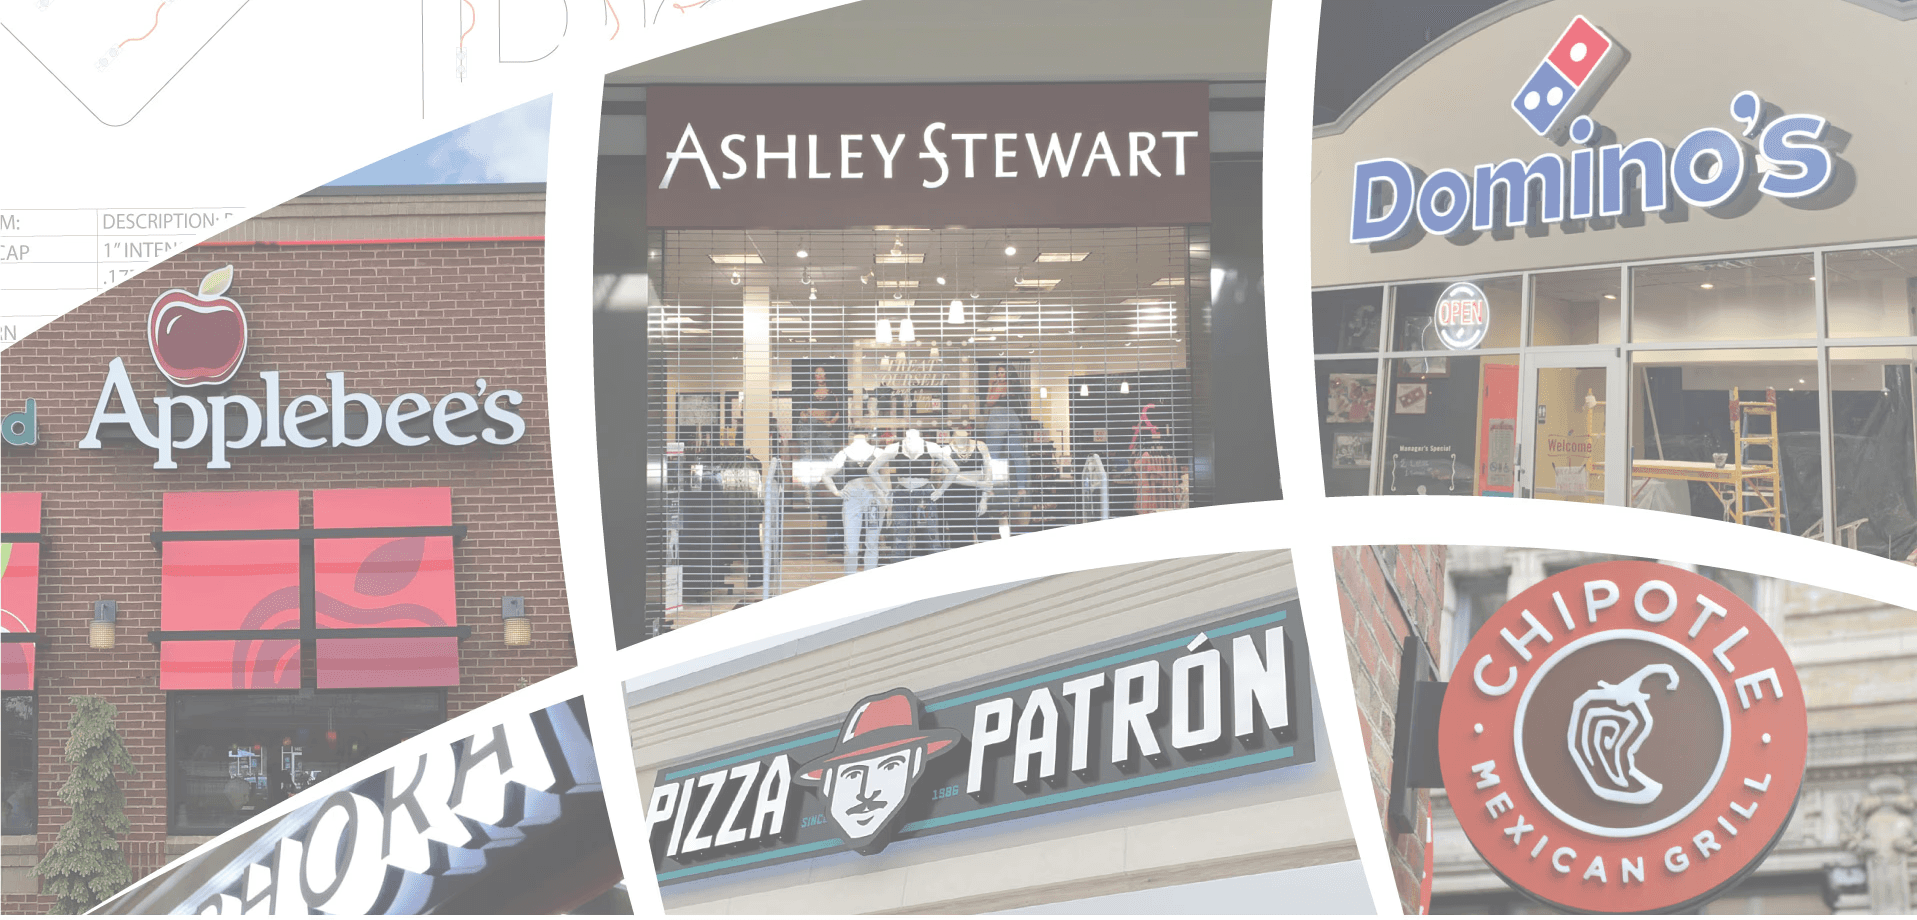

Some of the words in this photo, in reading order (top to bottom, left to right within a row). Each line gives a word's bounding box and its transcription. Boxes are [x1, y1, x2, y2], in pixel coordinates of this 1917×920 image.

[658, 122, 906, 190] ASHLEY
[919, 122, 1199, 189] STEWART
[1349, 91, 1831, 244] Domino's
[1438, 298, 1484, 327] OPEN
[79, 357, 526, 469] Applebee's
[1399, 444, 1429, 453] Manager's
[1430, 444, 1452, 453] Special
[1547, 438, 1593, 453] Welcome
[1473, 579, 1784, 709] CHIPOTLE
[646, 754, 792, 857] PIZZA
[966, 625, 1290, 796] PATRÓN
[801, 814, 829, 829] SINC
[932, 785, 959, 801] 1986
[1471, 759, 1645, 883] MEXICAN
[1663, 772, 1772, 873] GRILL
